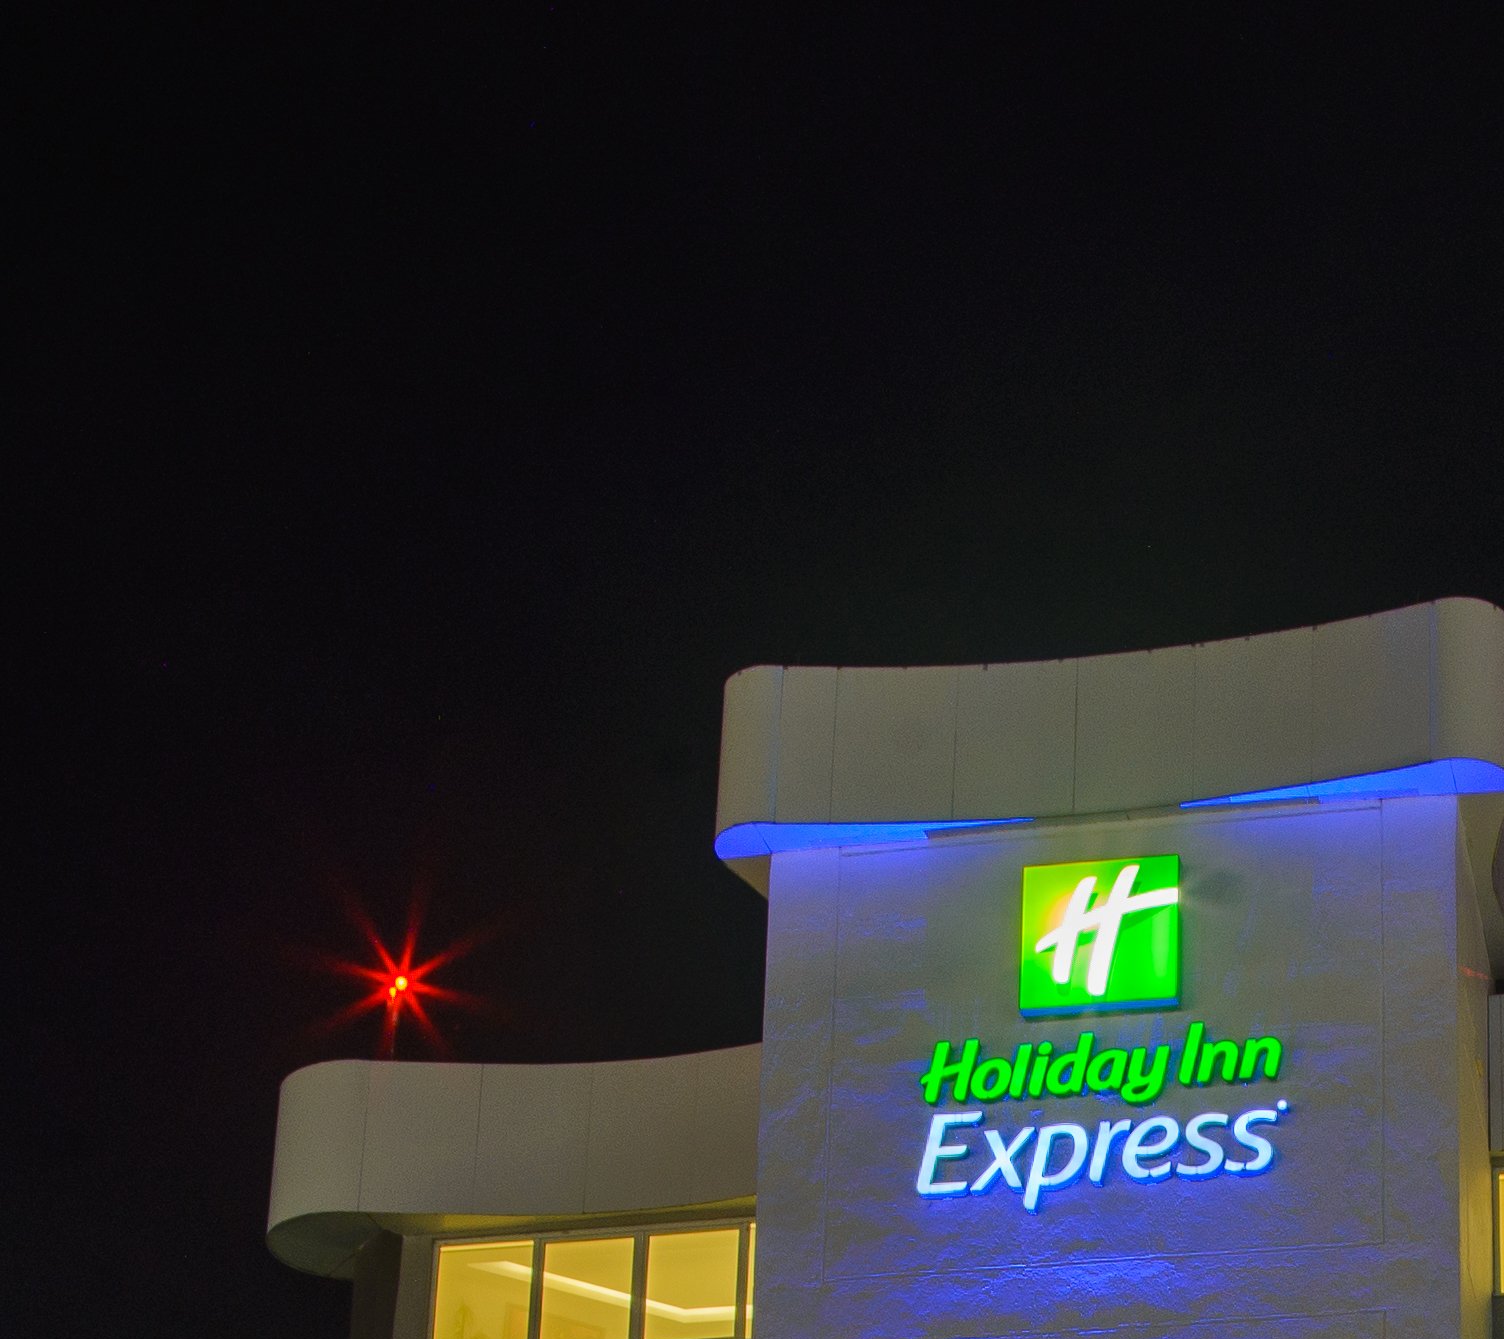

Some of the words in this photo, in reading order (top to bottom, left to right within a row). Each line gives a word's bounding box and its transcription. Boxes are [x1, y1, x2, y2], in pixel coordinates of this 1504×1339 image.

[919, 1031, 1172, 1104] Holiday
[1178, 1021, 1284, 1087] Inn
[916, 1108, 1280, 1215] Express
